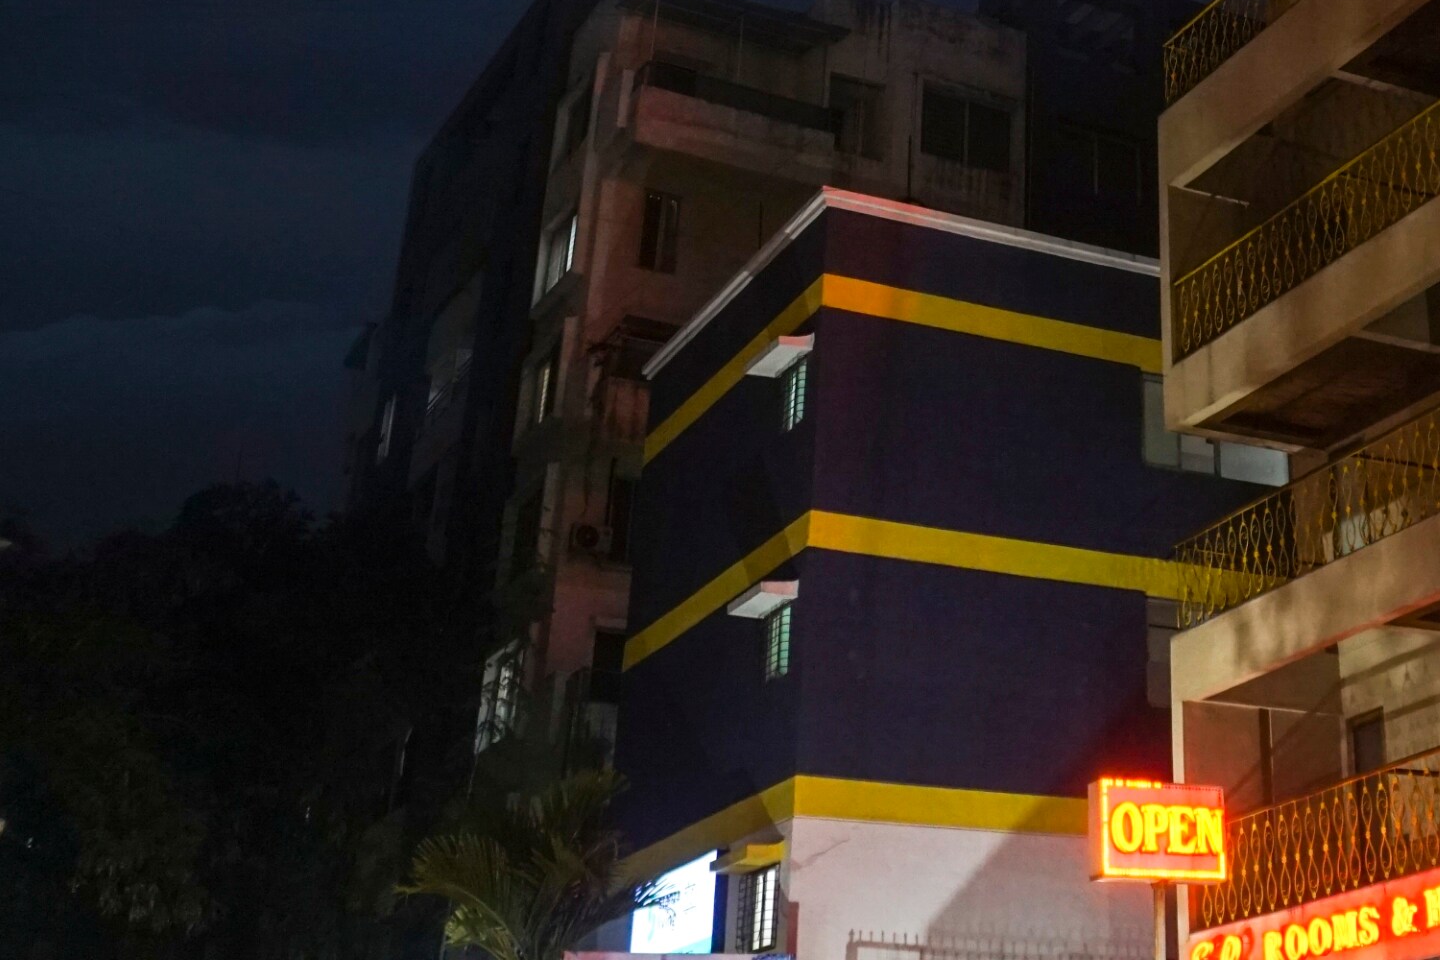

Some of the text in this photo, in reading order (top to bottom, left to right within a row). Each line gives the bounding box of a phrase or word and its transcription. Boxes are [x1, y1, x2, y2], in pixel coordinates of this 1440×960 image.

[1110, 800, 1225, 856] OPEN
[1262, 905, 1381, 960] ROOMS
[1391, 895, 1420, 937] &
